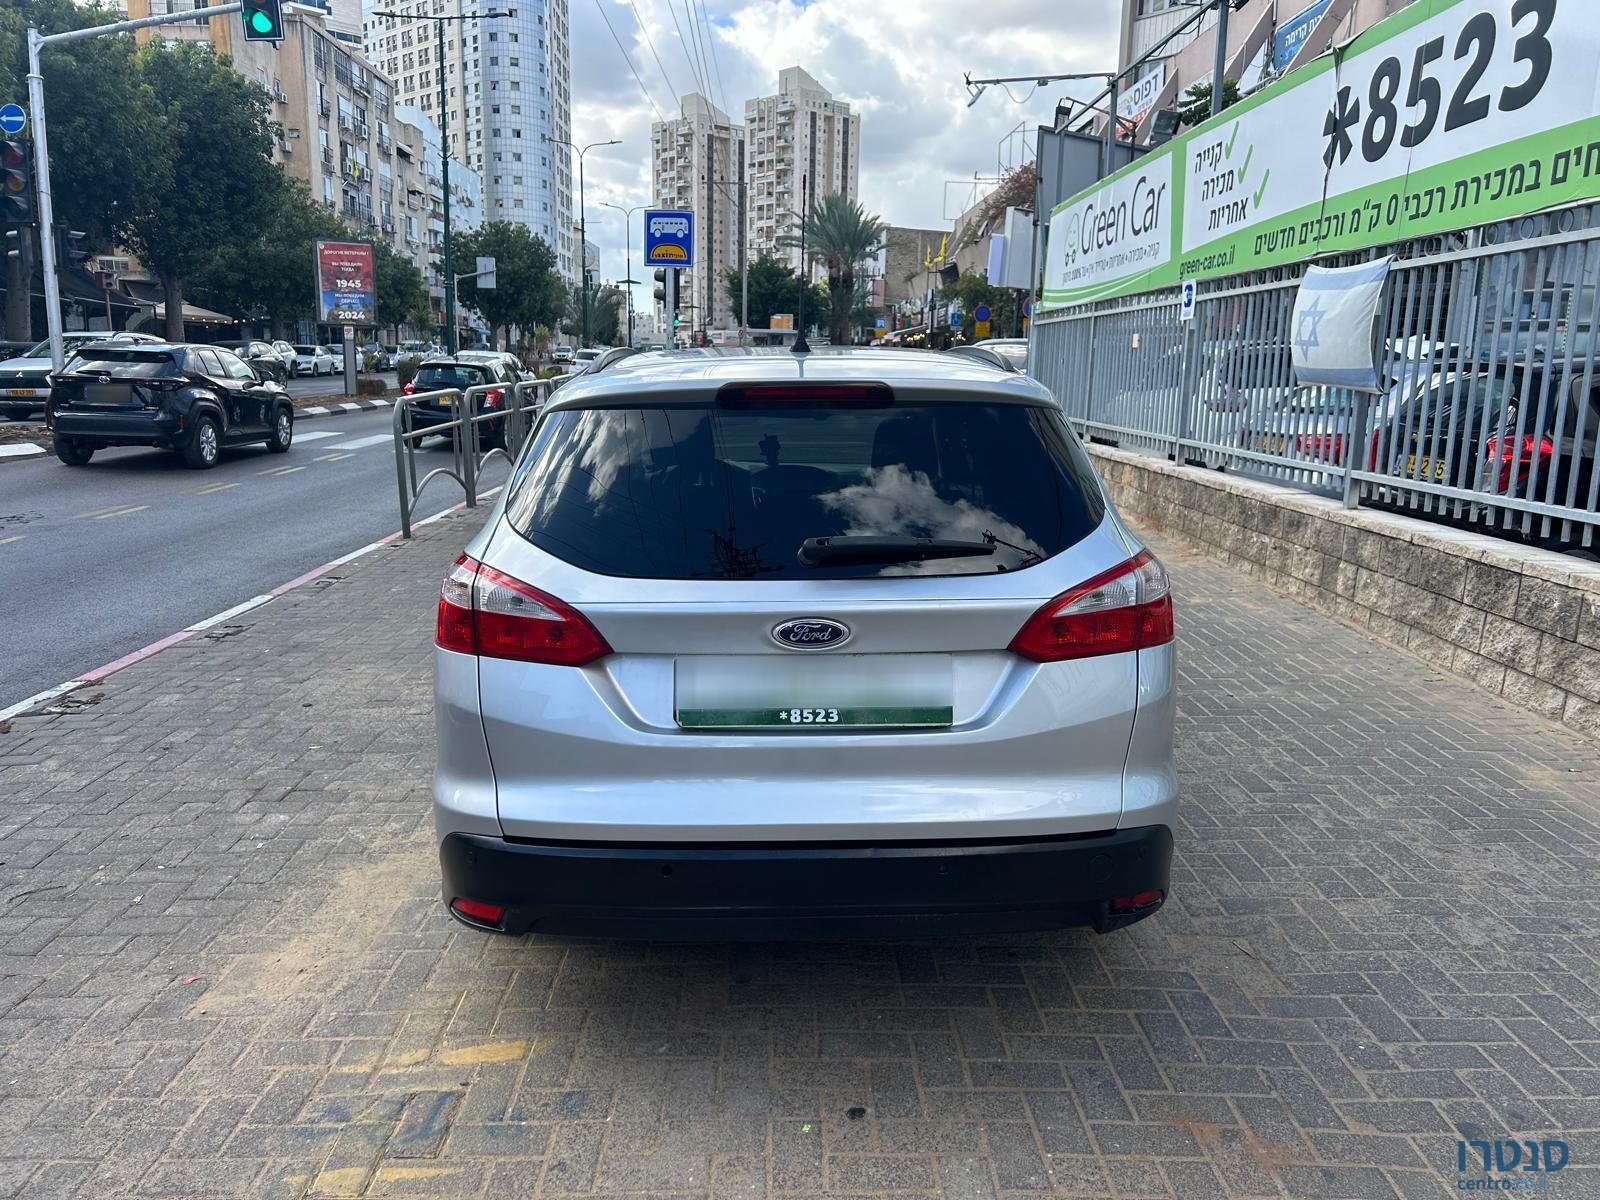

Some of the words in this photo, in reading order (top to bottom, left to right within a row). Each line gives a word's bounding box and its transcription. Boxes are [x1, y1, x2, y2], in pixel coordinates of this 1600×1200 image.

[1133, 73, 1159, 106] דפוס
[1195, 141, 1223, 174] קנייה
[1201, 169, 1235, 201] מכירה
[1450, 159, 1541, 211] במכירת
[1081, 201, 1127, 255] Green
[1131, 175, 1166, 237] Car
[1208, 197, 1249, 231] אחריות
[1386, 193, 1399, 226] 0
[1404, 185, 1446, 221] רכבי
[1254, 225, 1296, 256] חדשים
[1298, 212, 1346, 245] ורכבים
[1179, 246, 1236, 280] green-car.co.il
[336, 279, 362, 288] 1945
[338, 311, 366, 320] 2024
[789, 623, 832, 643] Ford
